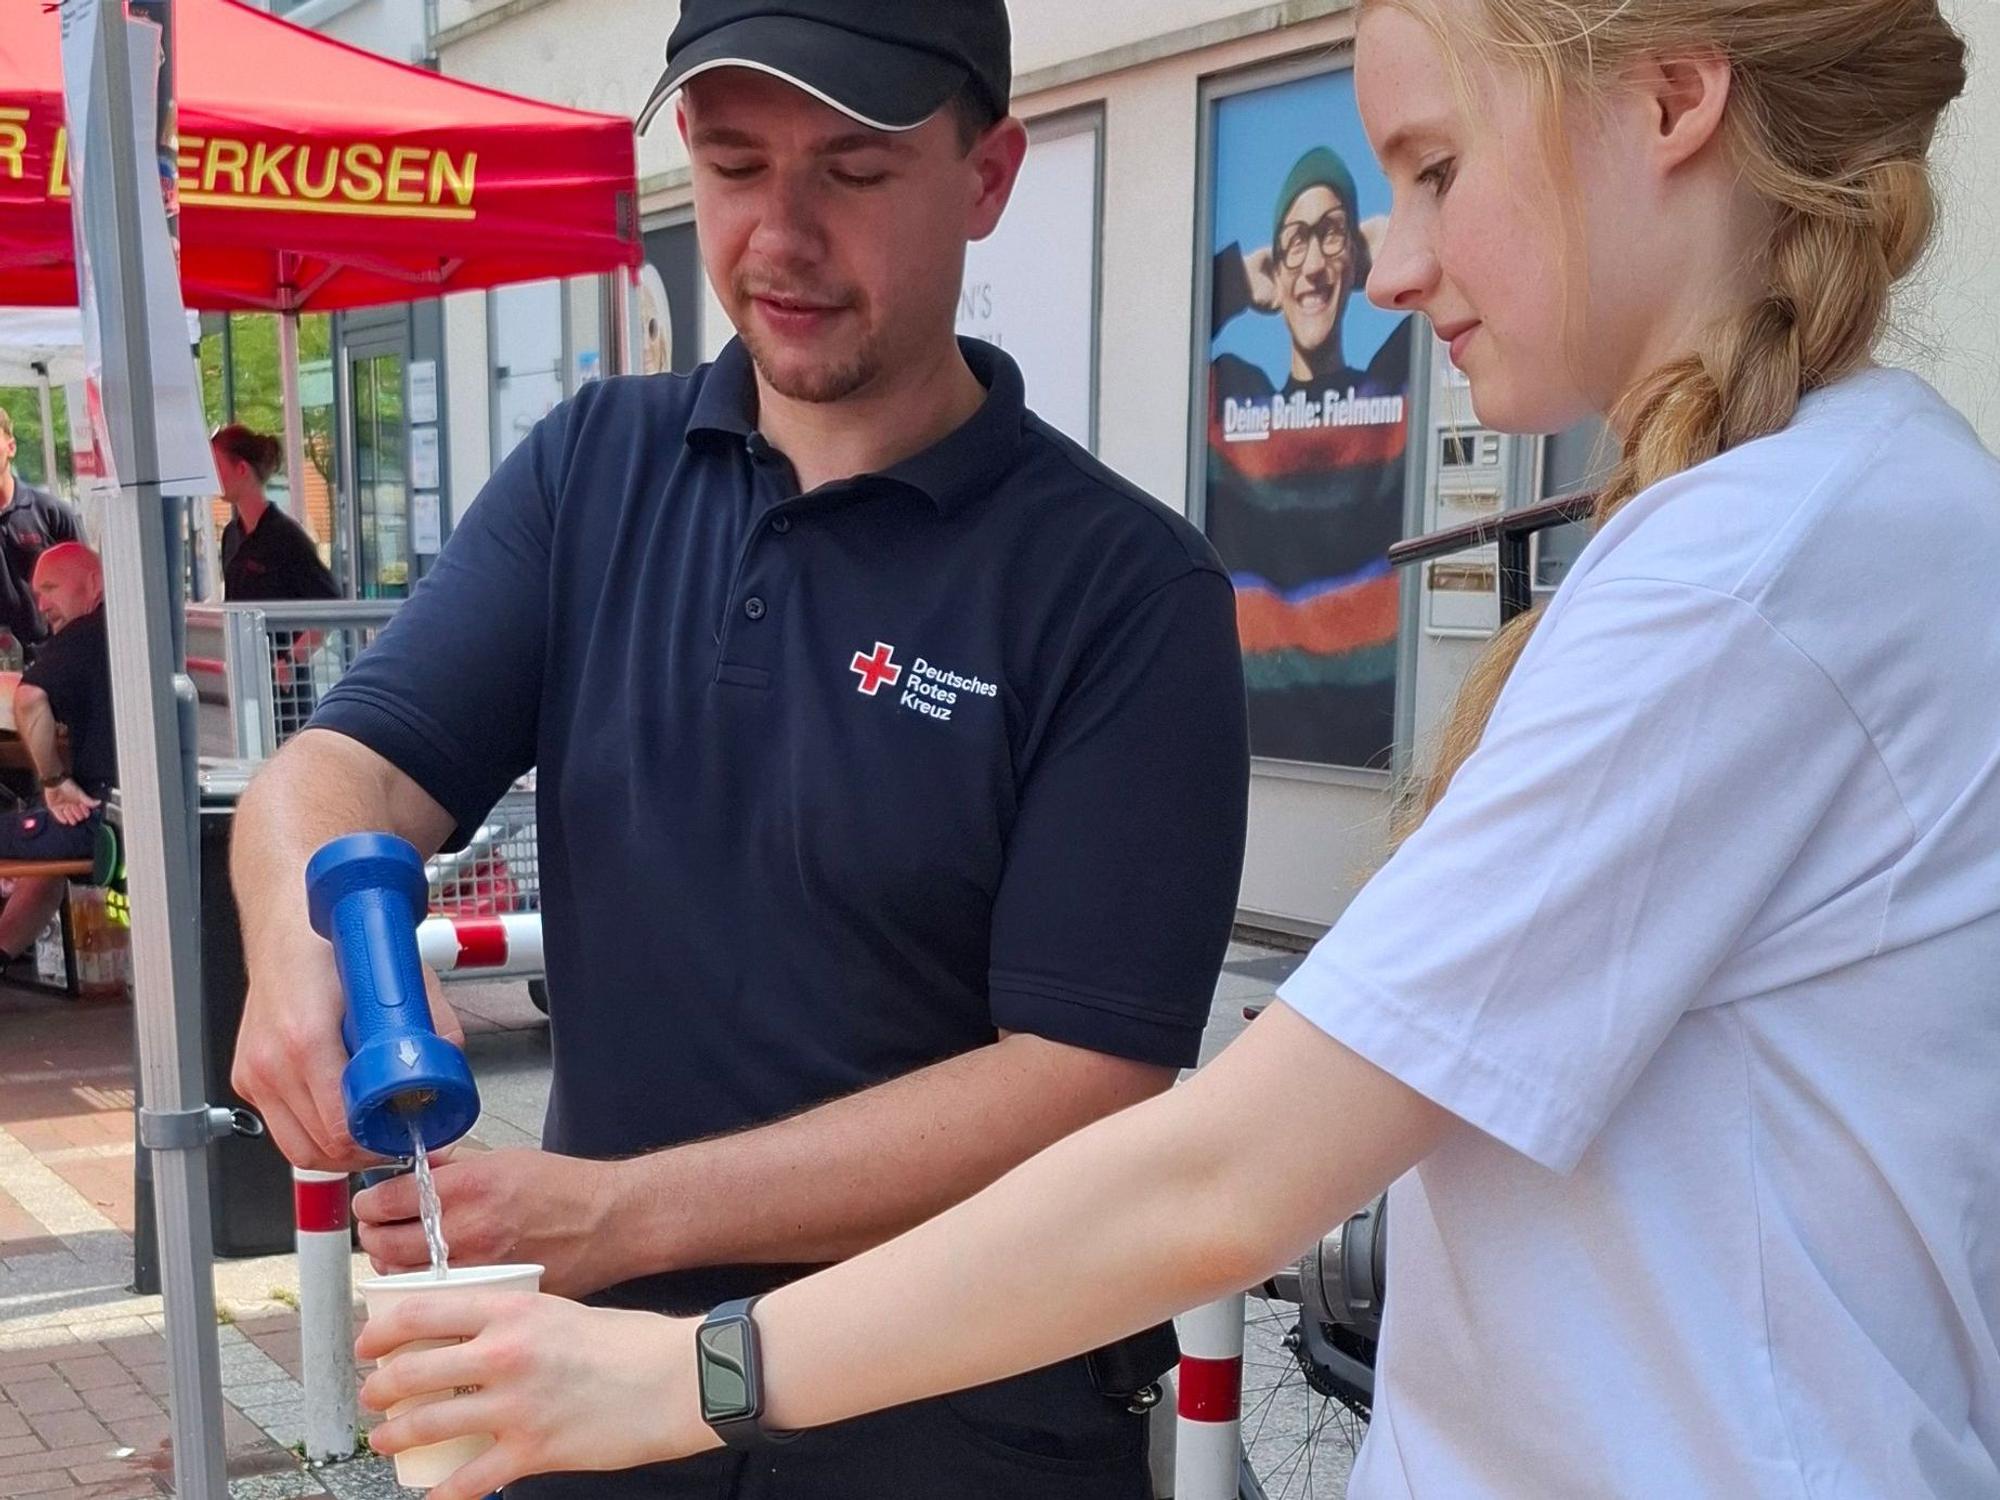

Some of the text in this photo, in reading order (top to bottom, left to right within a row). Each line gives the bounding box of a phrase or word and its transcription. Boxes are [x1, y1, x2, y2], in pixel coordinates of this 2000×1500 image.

[48, 126, 478, 206] LERKUSEN
[1223, 385, 1403, 433] Deine Brille: Fielmann
[906, 673, 958, 705] Rotes
[912, 657, 998, 698] Deutsches
[900, 689, 952, 721] Kreuz
